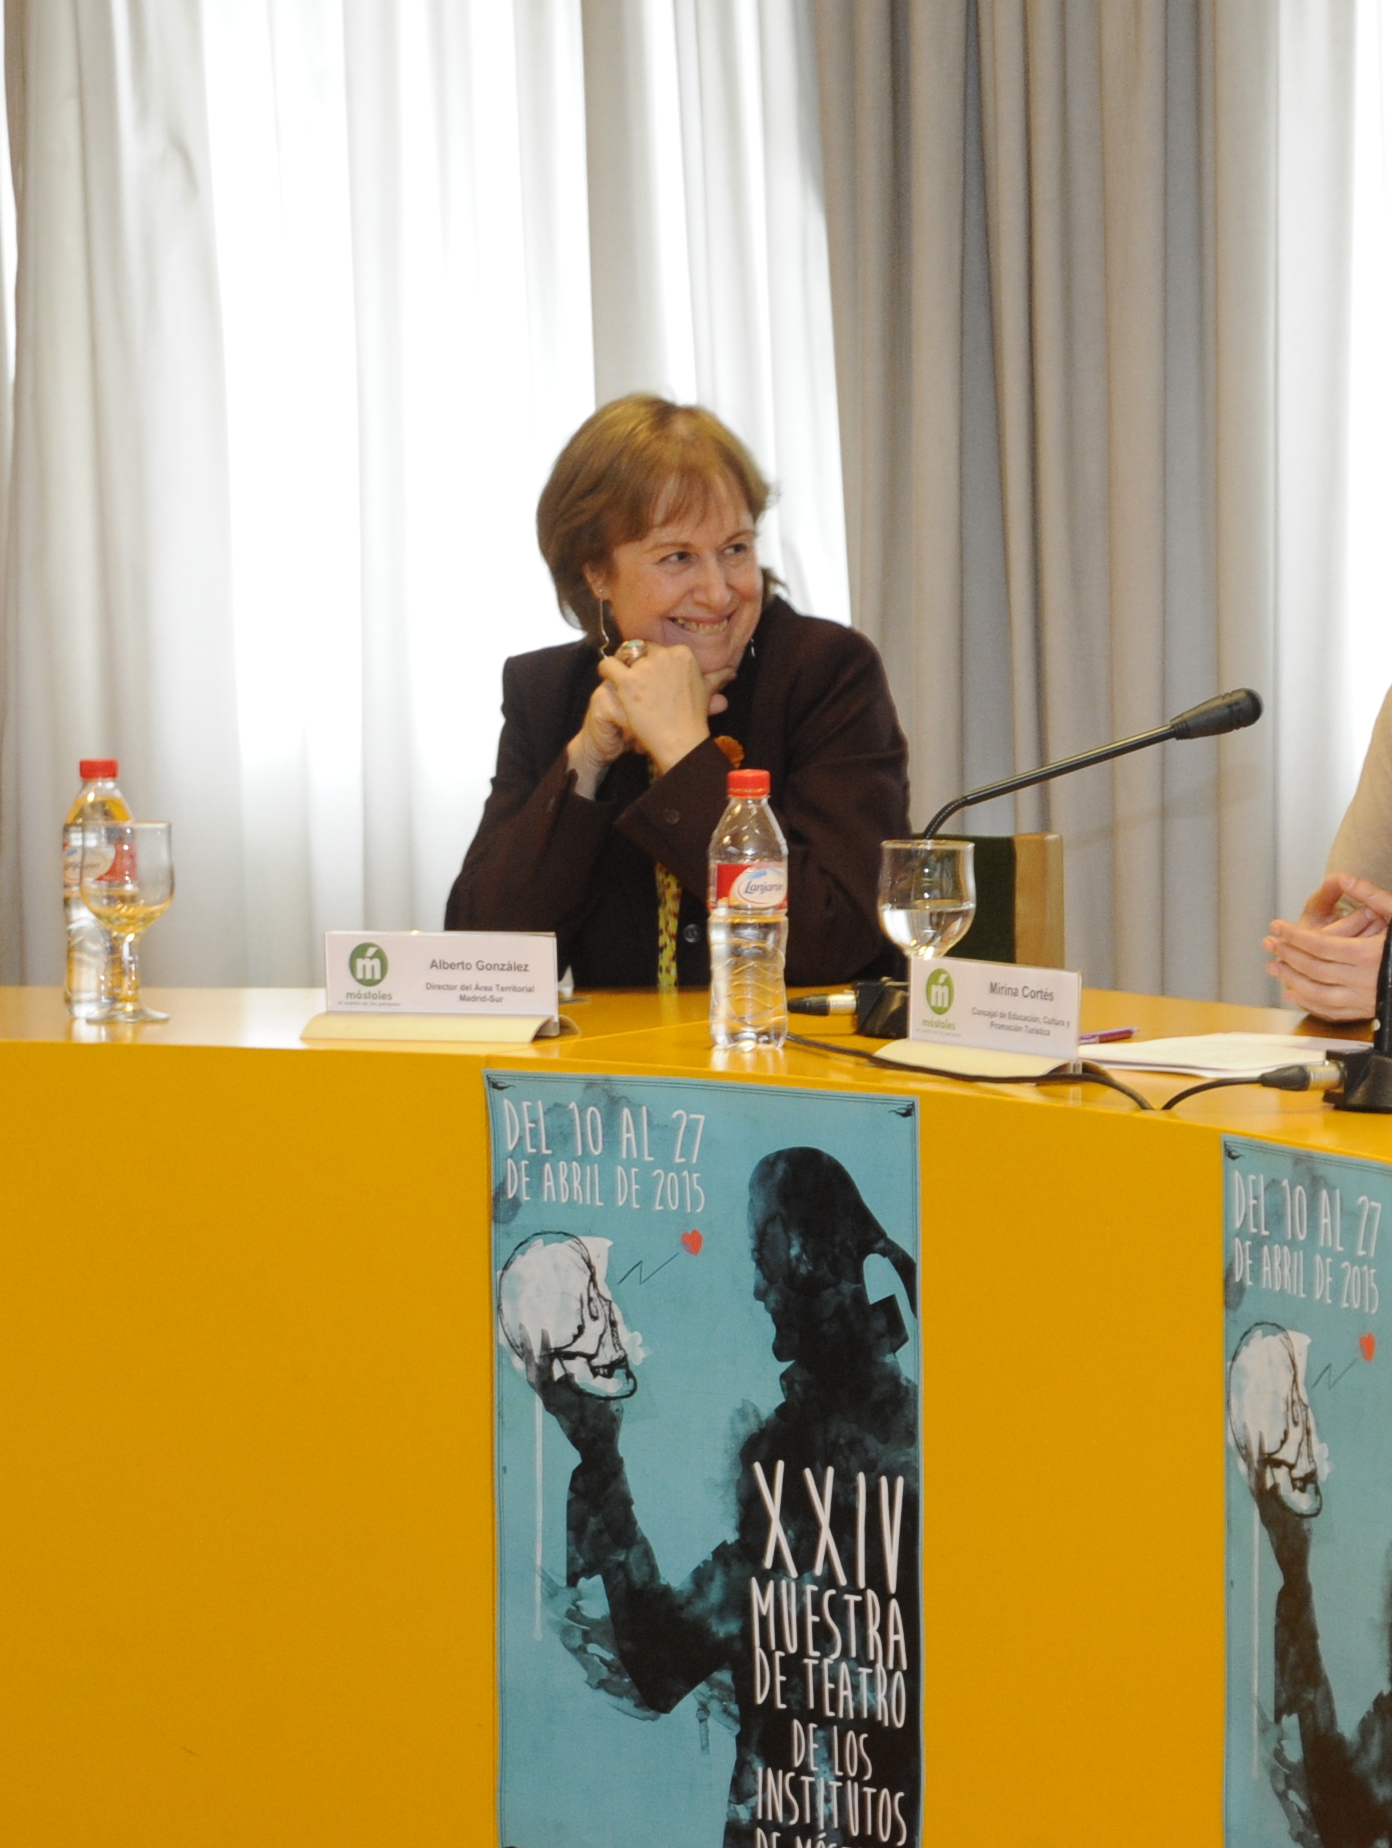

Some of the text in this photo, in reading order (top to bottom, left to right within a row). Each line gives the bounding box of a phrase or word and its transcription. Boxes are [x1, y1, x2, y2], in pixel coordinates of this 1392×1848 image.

[346, 989, 392, 1001] móstoles
[426, 982, 535, 993] Director del Área Territorial
[430, 959, 530, 973] Alberto González
[990, 981, 1055, 1001] Mirina Cortés
[459, 993, 504, 1003] Madrid-Sur
[990, 1020, 1023, 1032] Promoción
[999, 1011, 1007, 1019] de
[1043, 1016, 1065, 1026] Cultura
[502, 1097, 706, 1164] DEL 10 AL 27
[506, 1157, 705, 1213] DE ABRIL DE 2015
[1234, 1169, 1382, 1258] DEL 10 AL 27
[1234, 1237, 1379, 1314] DE ABRIL DE 2015
[753, 1459, 904, 1594] XXIV
[751, 1576, 908, 1671] MUESTRA
[755, 1646, 906, 1729] DE TEATRO
[793, 1718, 872, 1781] DE LOS
[757, 1767, 907, 1847] INSTITUTOS
